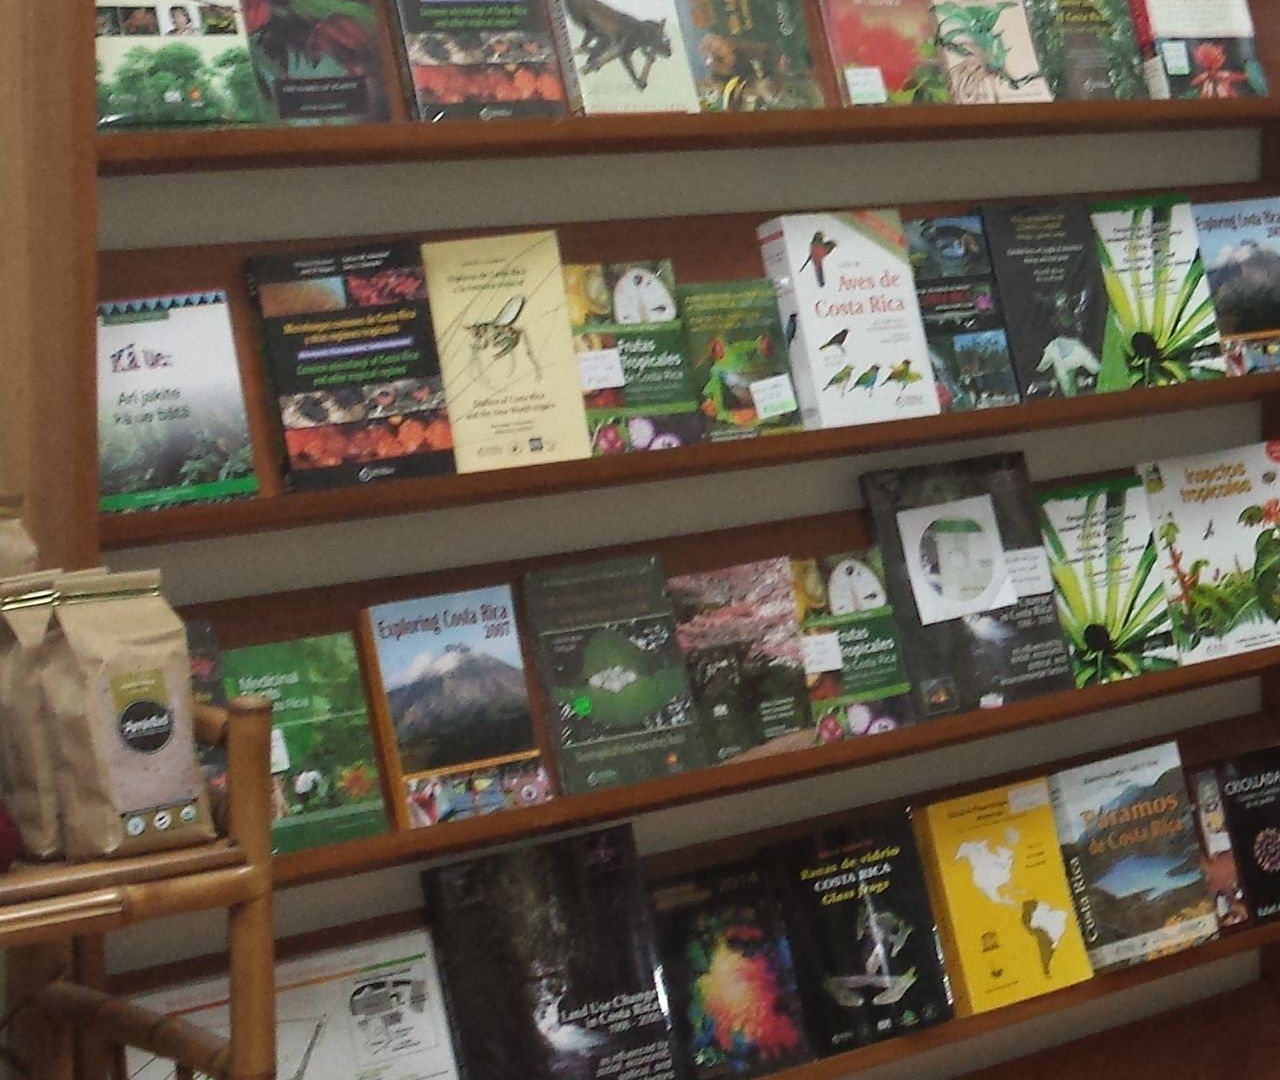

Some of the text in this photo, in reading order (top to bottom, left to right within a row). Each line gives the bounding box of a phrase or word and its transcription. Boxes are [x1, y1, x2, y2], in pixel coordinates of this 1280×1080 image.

[838, 269, 900, 292] Aves de
[815, 300, 865, 318] Costa
[869, 294, 905, 313] Rica
[378, 603, 508, 640] Exploring Costa Rica
[1081, 793, 1179, 831] Páramos
[859, 845, 901, 865] vidrio
[1088, 838, 1106, 856] de
[1107, 826, 1148, 850] Costa
[814, 861, 892, 892] COSTA RICA
[1079, 895, 1098, 943] Costa
